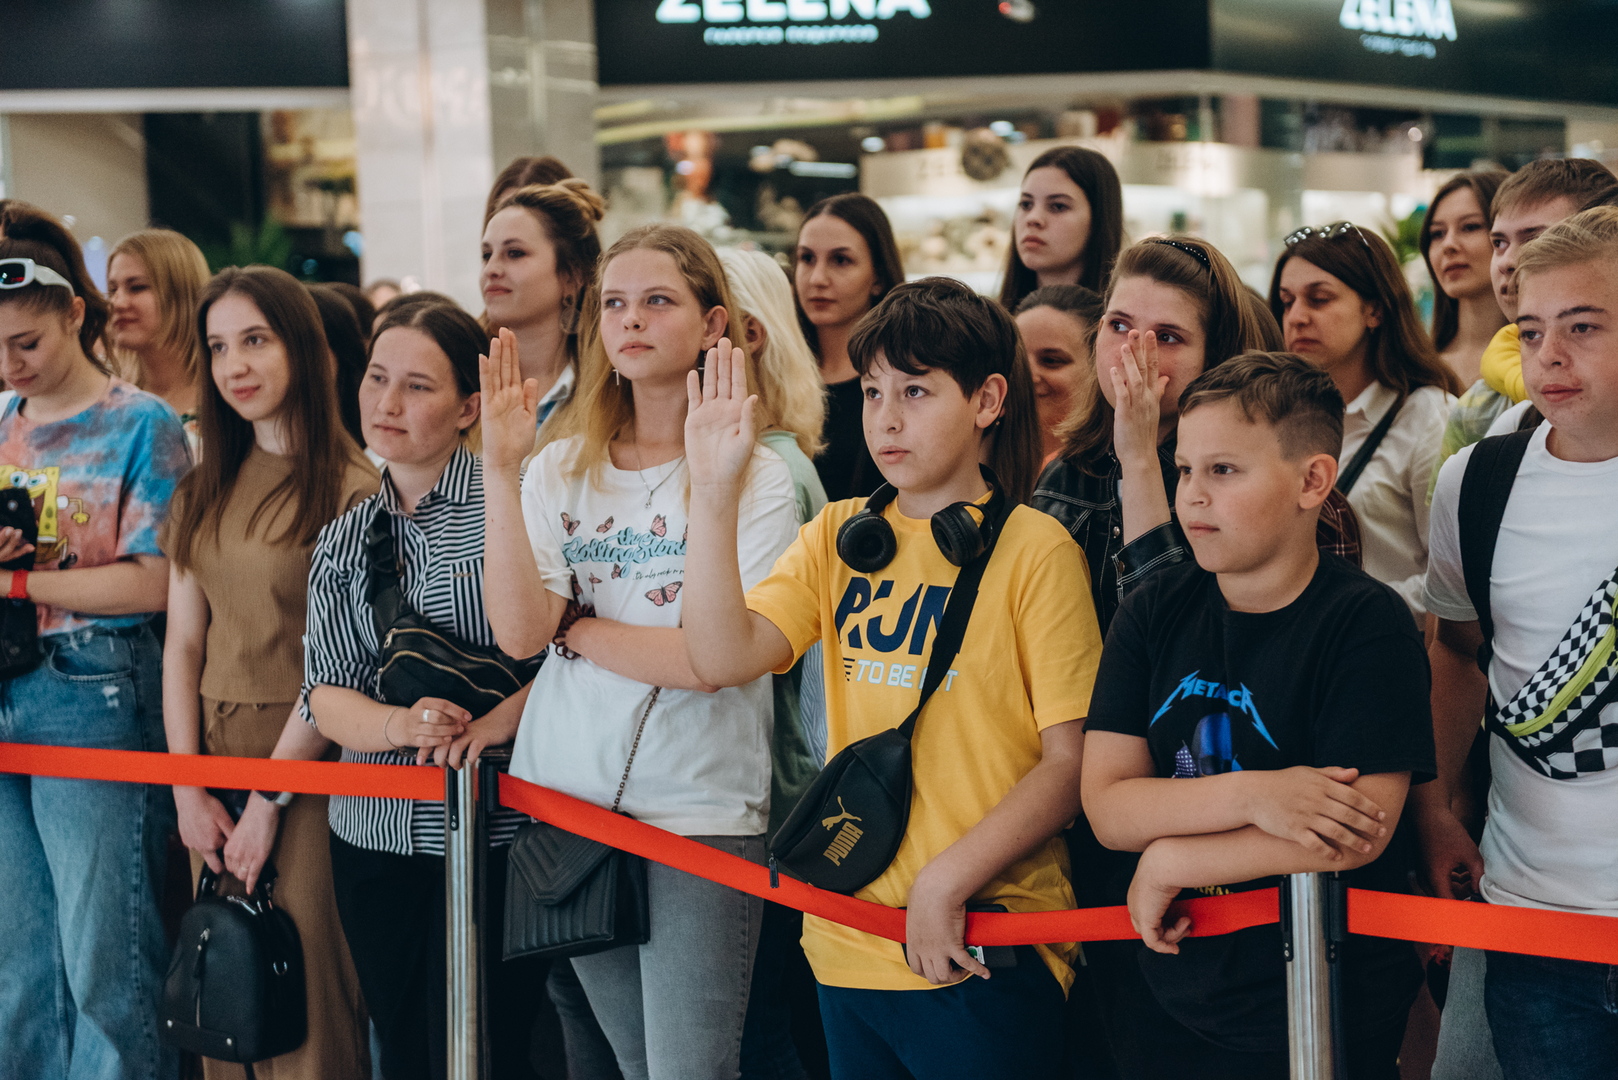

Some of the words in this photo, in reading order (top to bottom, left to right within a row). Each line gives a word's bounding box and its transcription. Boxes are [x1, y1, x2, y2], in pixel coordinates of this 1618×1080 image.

[834, 576, 955, 656] RUN
[856, 659, 885, 684] TO
[886, 663, 917, 688] BE
[822, 821, 864, 867] PUMA
